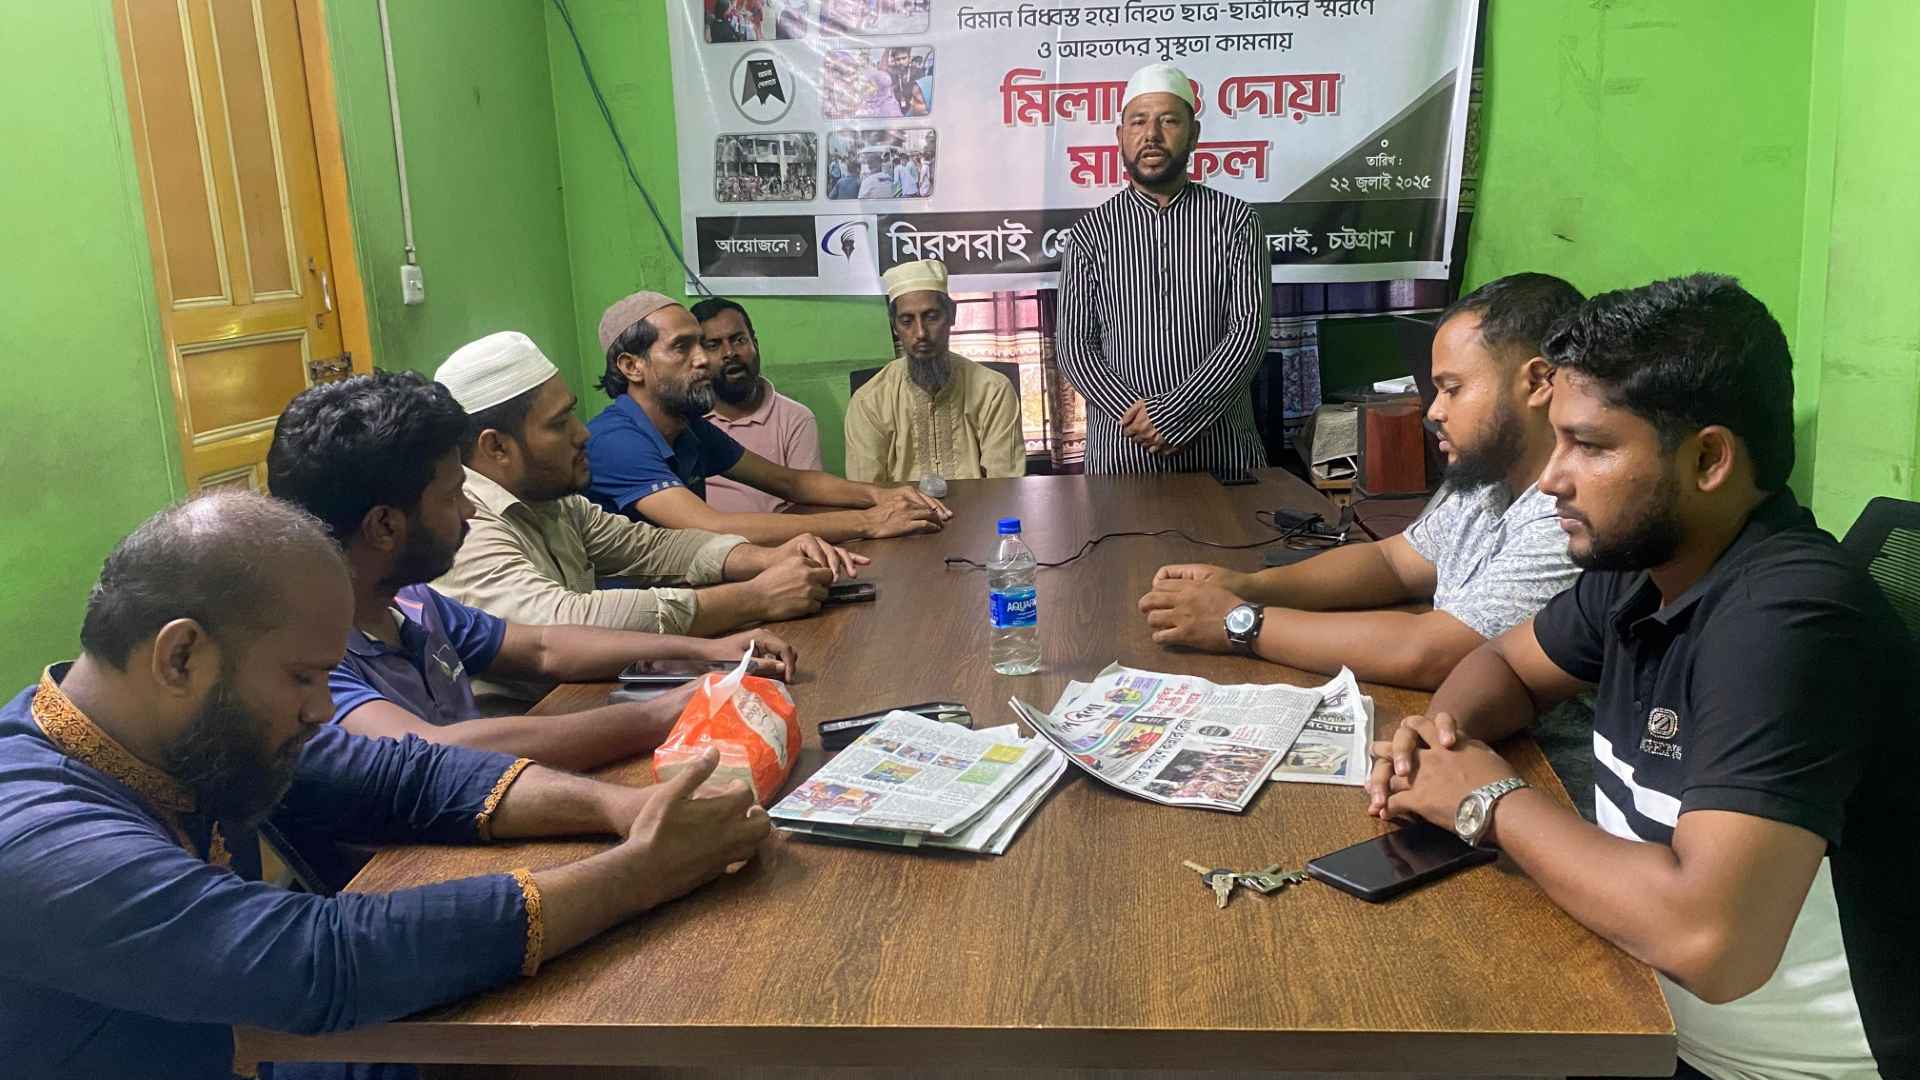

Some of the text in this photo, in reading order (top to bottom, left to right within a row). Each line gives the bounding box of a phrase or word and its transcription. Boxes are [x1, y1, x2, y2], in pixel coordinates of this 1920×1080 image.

[957, 6, 1013, 30] বিমান
[1017, 4, 1080, 27] বিধ্বস্ত
[1084, 6, 1120, 26] হয়ে
[1124, 0, 1176, 23] নিহত
[1037, 33, 1294, 61] ও আহতদের সুস্থতা কামনায়
[1218, 73, 1341, 123] দোয়া
[1330, 177, 1351, 192] ২২
[1396, 175, 1432, 190] ২০২৫
[714, 238, 790, 254] আয়োজনে
[885, 219, 1033, 264] মিরসরাই
[1326, 225, 1396, 250] চট্টগ্রাম
